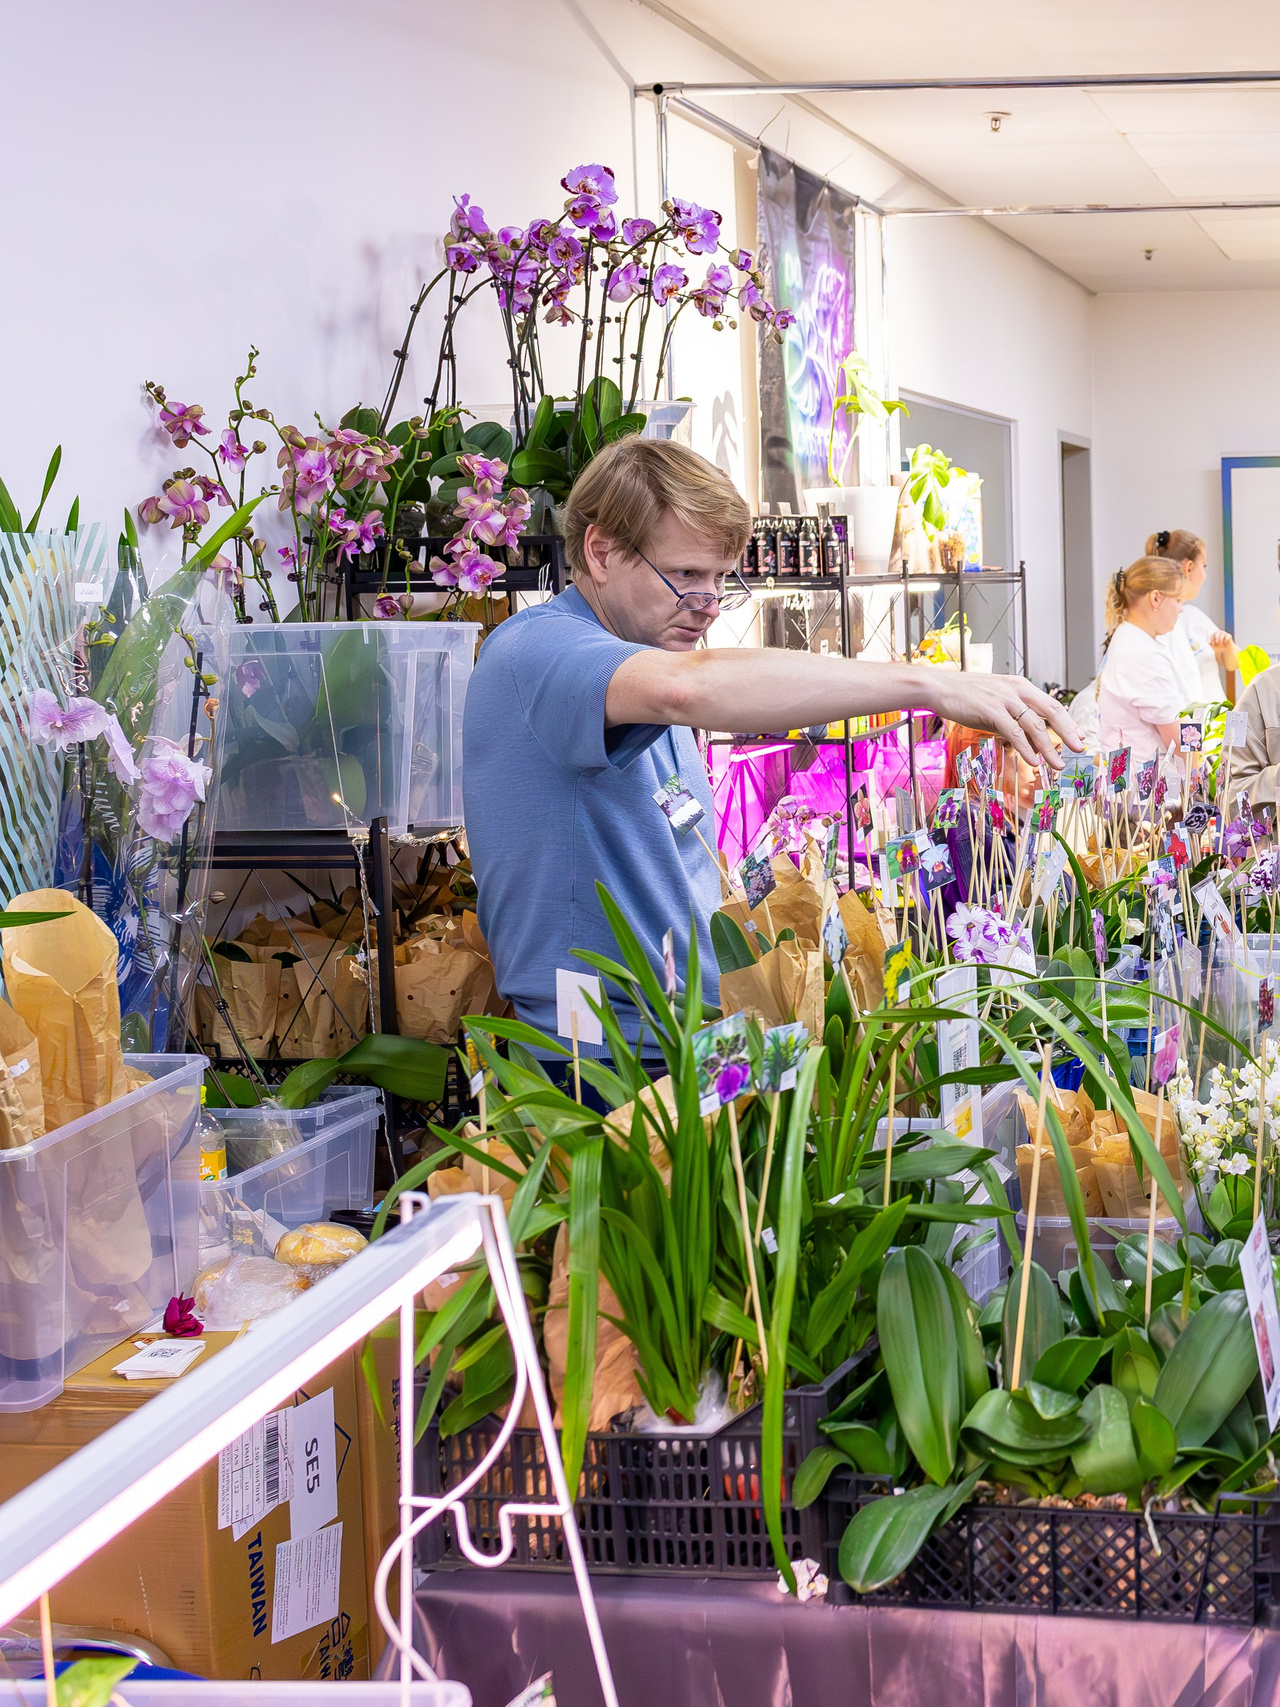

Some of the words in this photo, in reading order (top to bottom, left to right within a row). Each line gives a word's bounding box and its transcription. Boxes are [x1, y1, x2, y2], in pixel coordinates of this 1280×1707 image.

[305, 1437, 320, 1494] SE5
[247, 1531, 268, 1638] TAIWAN
[319, 1629, 333, 1680] TAIW
